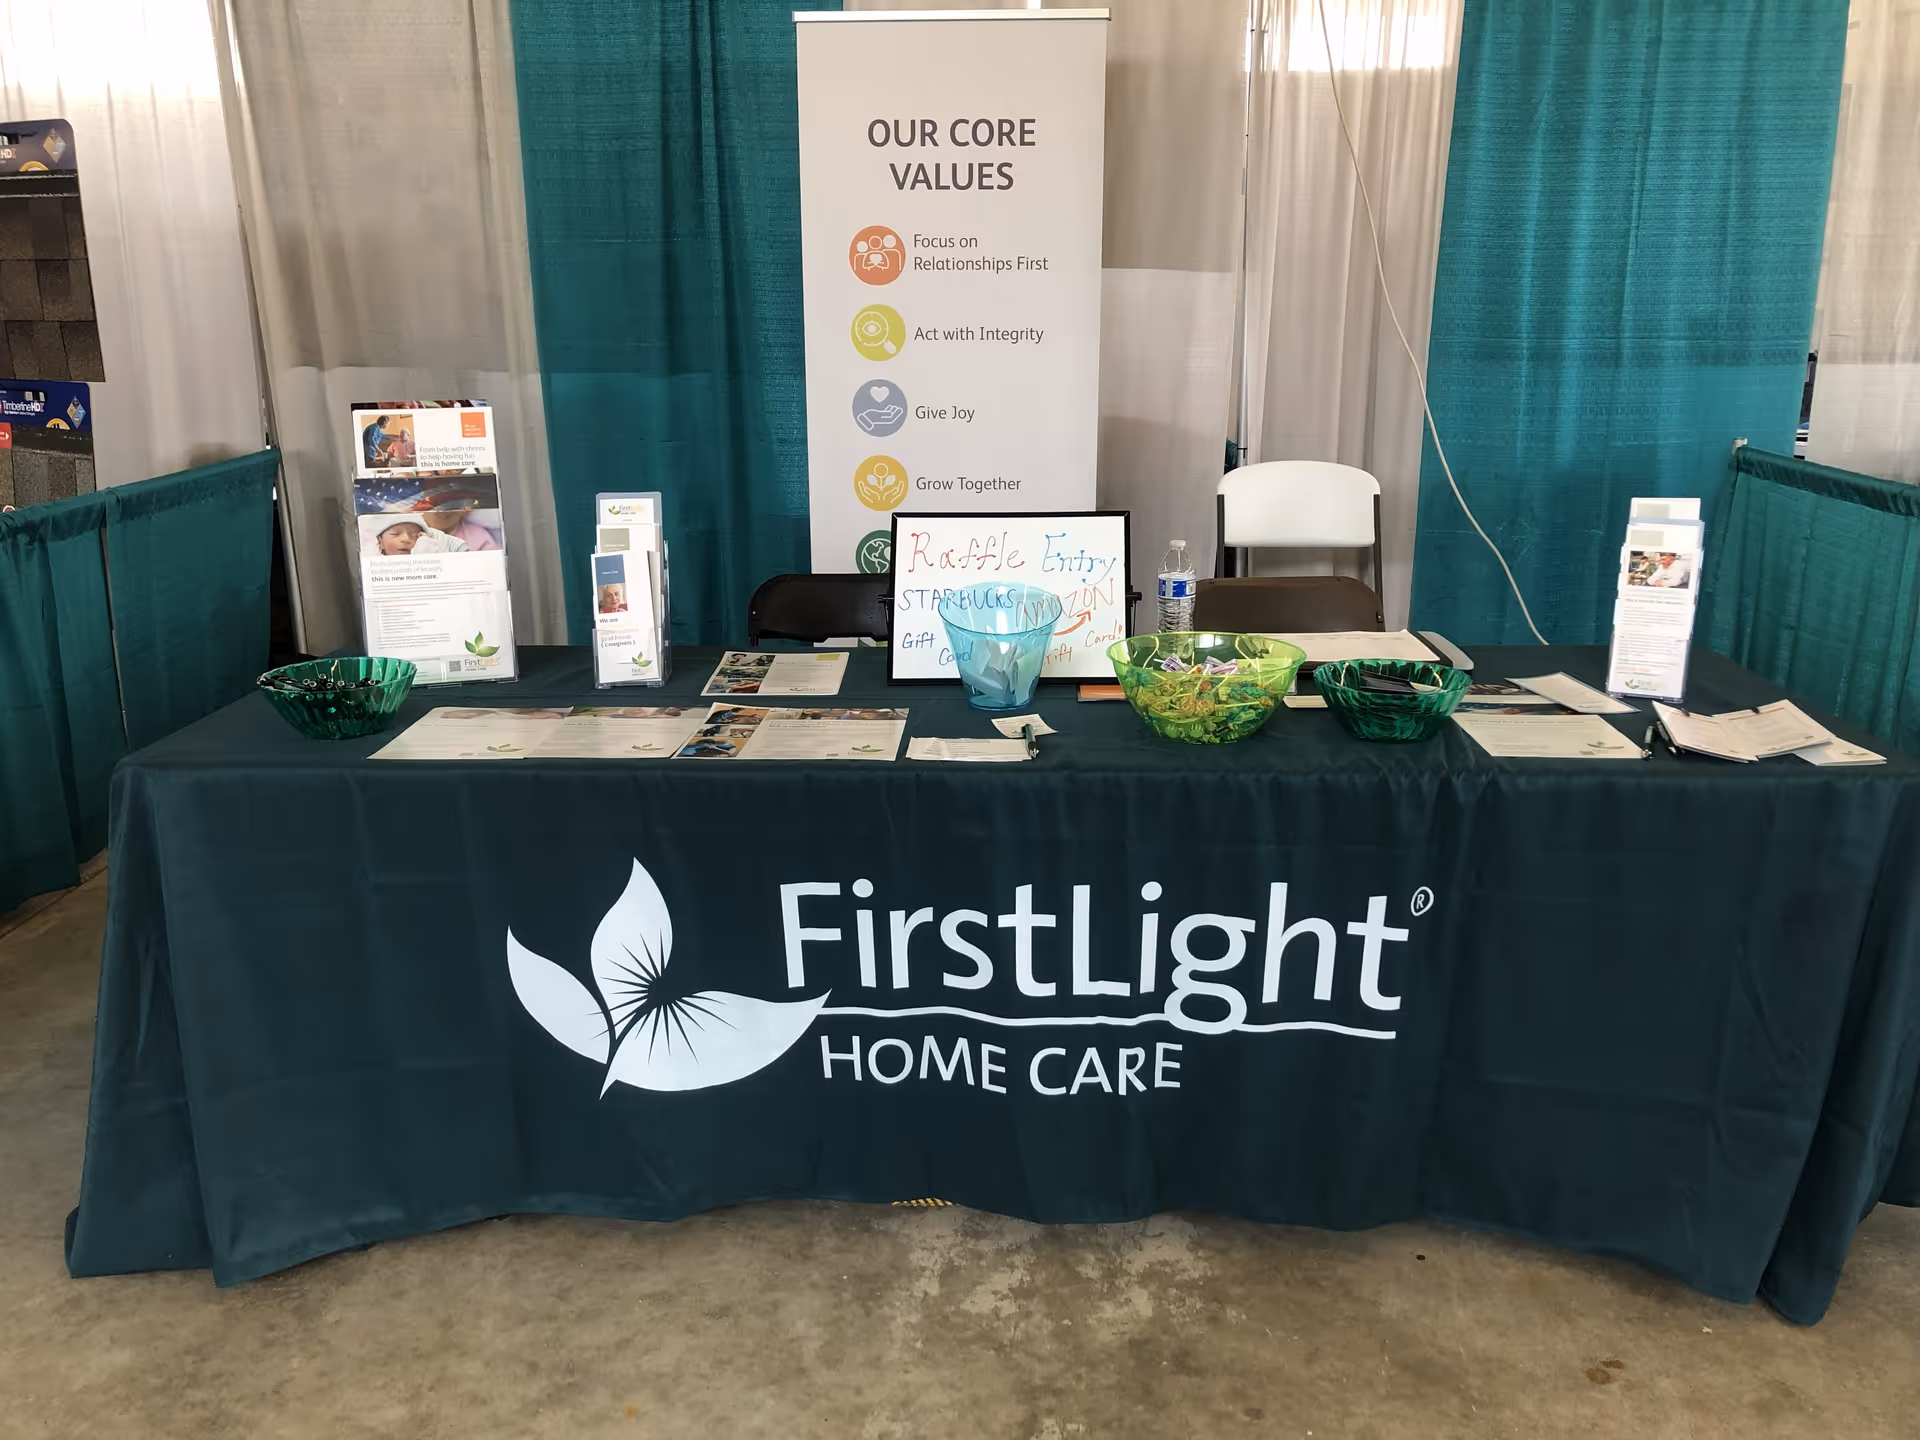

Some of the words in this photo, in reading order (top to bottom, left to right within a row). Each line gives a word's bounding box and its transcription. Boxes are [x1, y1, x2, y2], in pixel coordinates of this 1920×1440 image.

[868, 119, 939, 147] OUR
[950, 118, 1036, 147] CORE
[889, 162, 1014, 190] VALUES
[914, 234, 954, 248] Focus
[959, 236, 978, 248] on
[914, 256, 1012, 274] Relationships
[1017, 256, 1049, 270] First
[914, 327, 938, 341] Act
[943, 327, 974, 341] with
[979, 326, 1044, 344] Integrity
[915, 406, 947, 419] Give
[952, 406, 975, 422] Joy
[441, 459, 460, 467] home
[916, 477, 953, 490] Grow
[957, 477, 1021, 493] Together
[908, 532, 1025, 573] Raffle
[1041, 533, 1117, 586] Entry
[898, 588, 1017, 611] STARBUCKS
[902, 632, 936, 649] Gift
[1085, 618, 1122, 647] Card!
[938, 641, 973, 666] Card
[820, 1035, 1007, 1095] HOME
[1029, 1042, 1183, 1096] CARE
